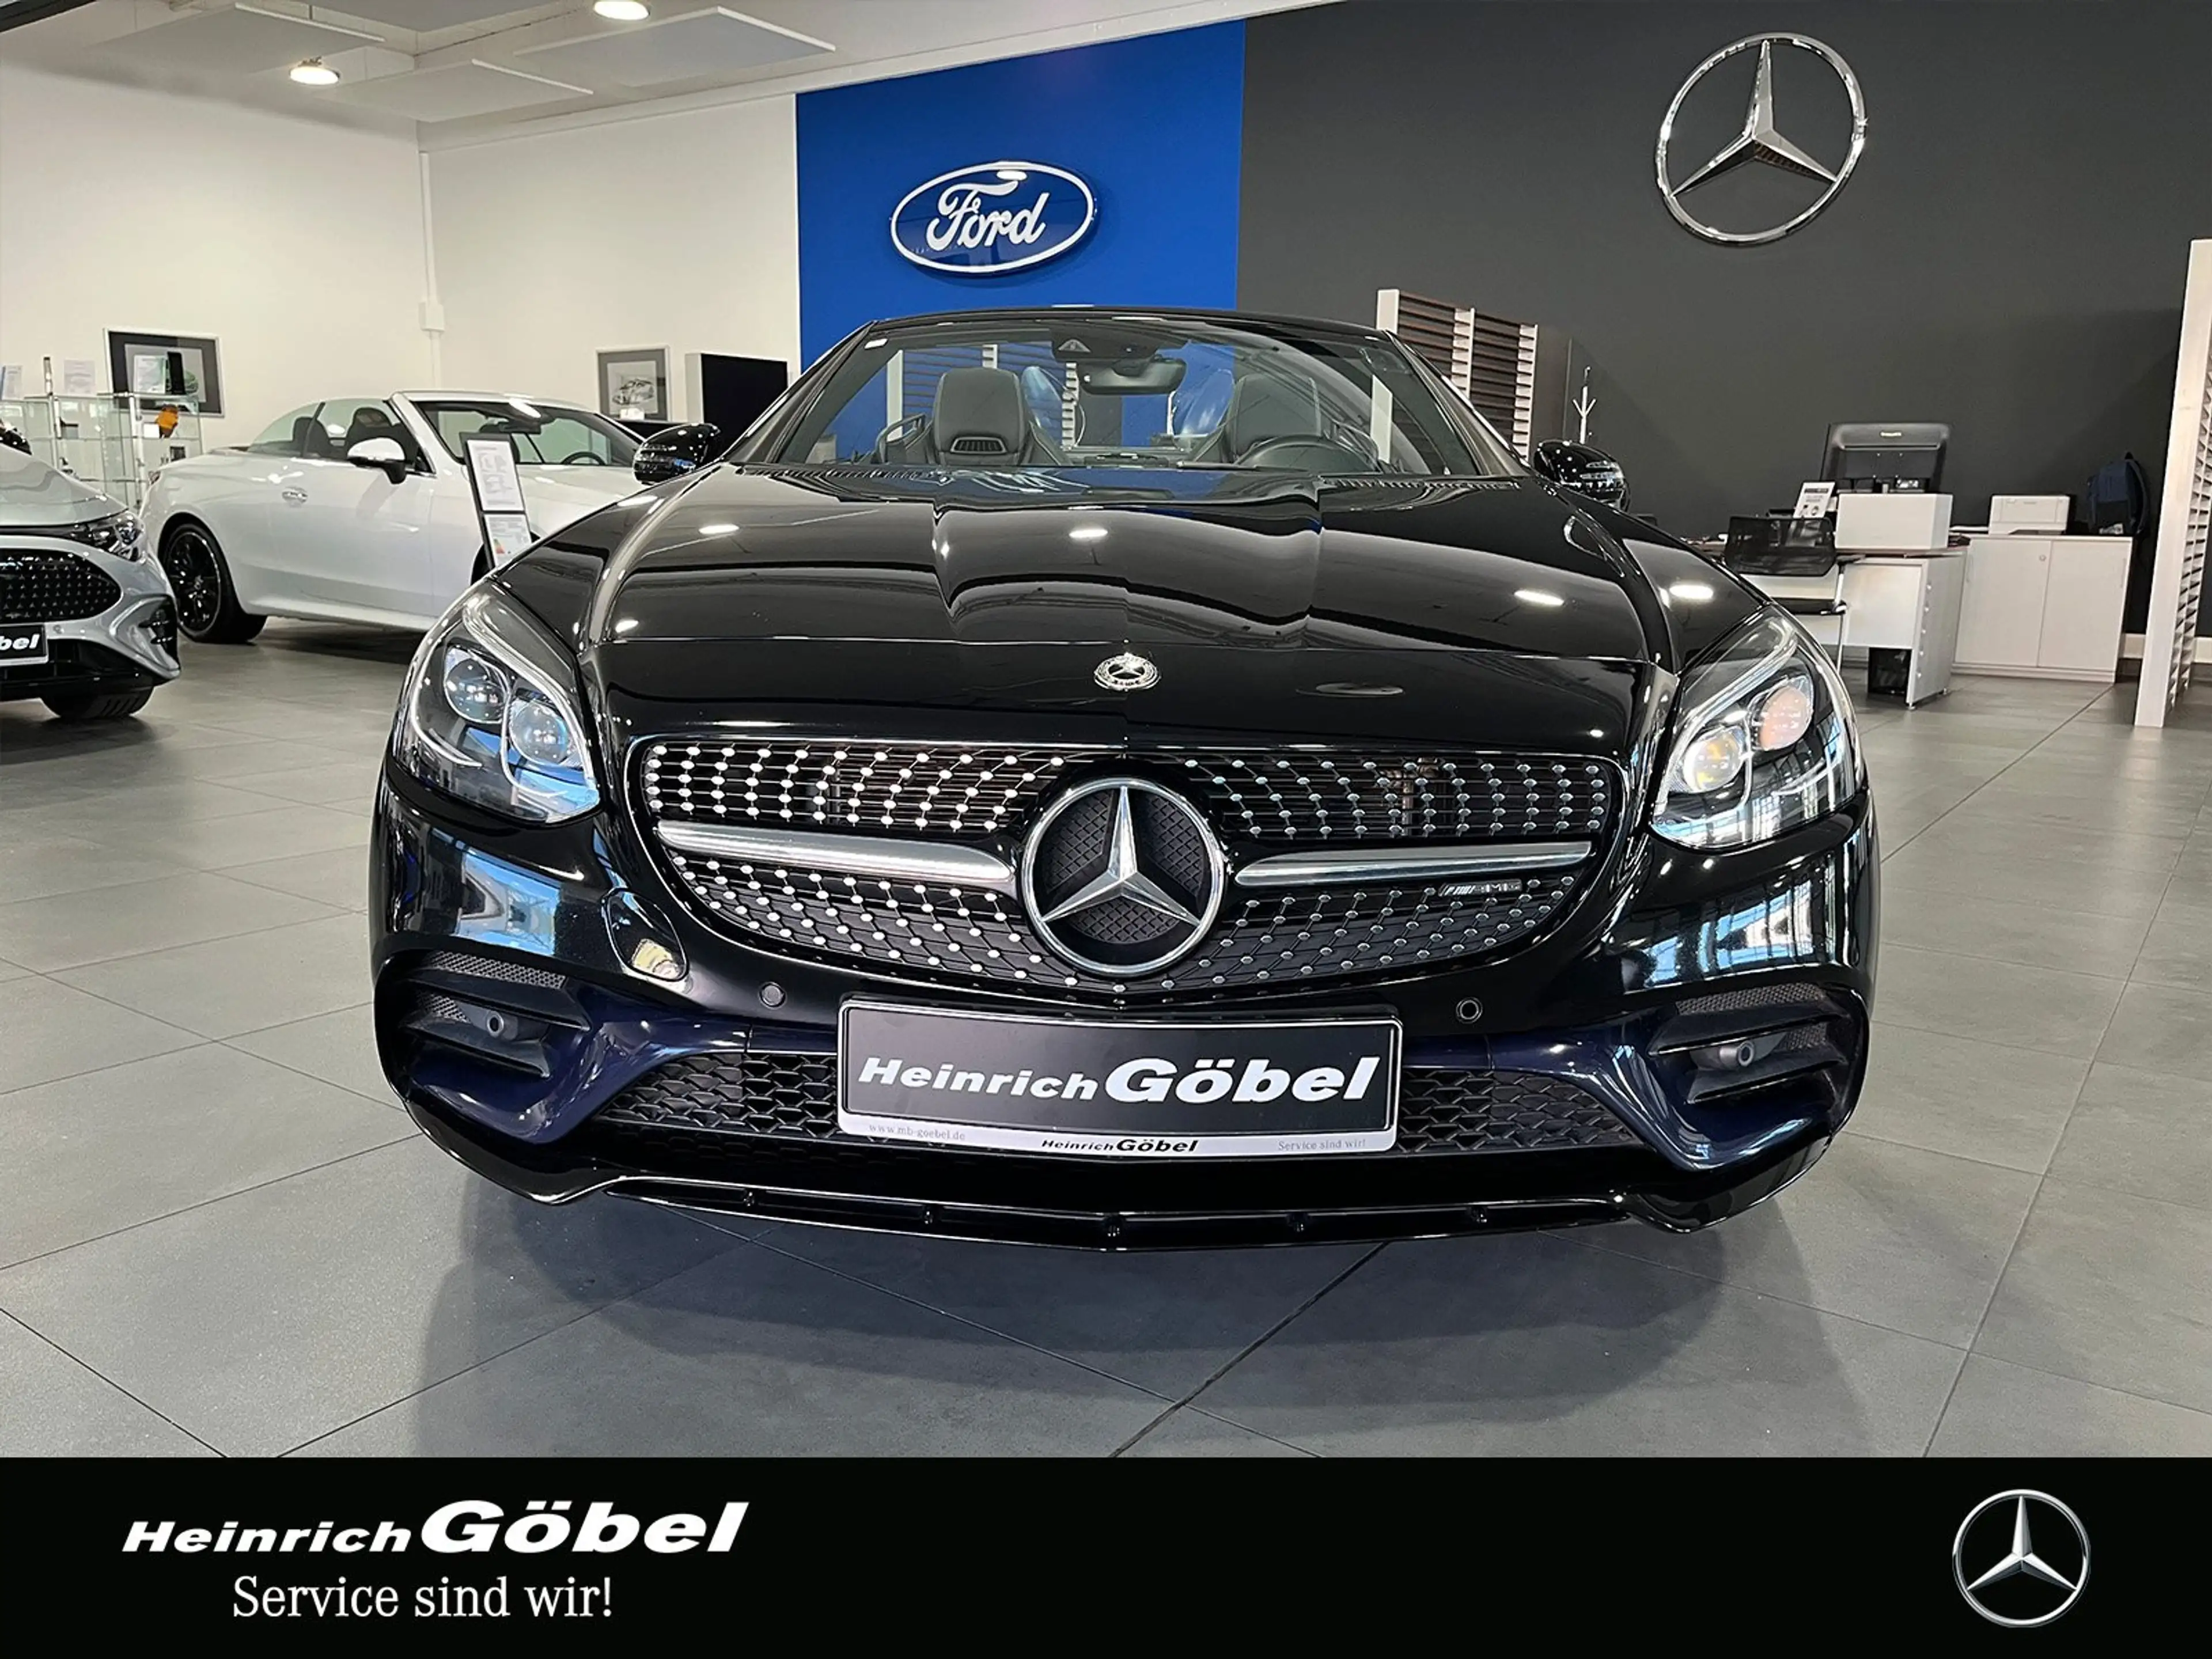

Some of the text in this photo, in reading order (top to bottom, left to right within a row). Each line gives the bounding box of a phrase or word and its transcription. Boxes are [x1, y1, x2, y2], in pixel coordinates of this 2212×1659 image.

[926, 180, 1050, 251] Ford
[858, 1057, 1380, 1103] Heinrich Göbel
[869, 1124, 966, 1141] www.mb-goebel.de
[1041, 1139, 1198, 1152] Heinrich Göbel
[1278, 1140, 1317, 1151] Service
[1319, 1139, 1342, 1150] sind
